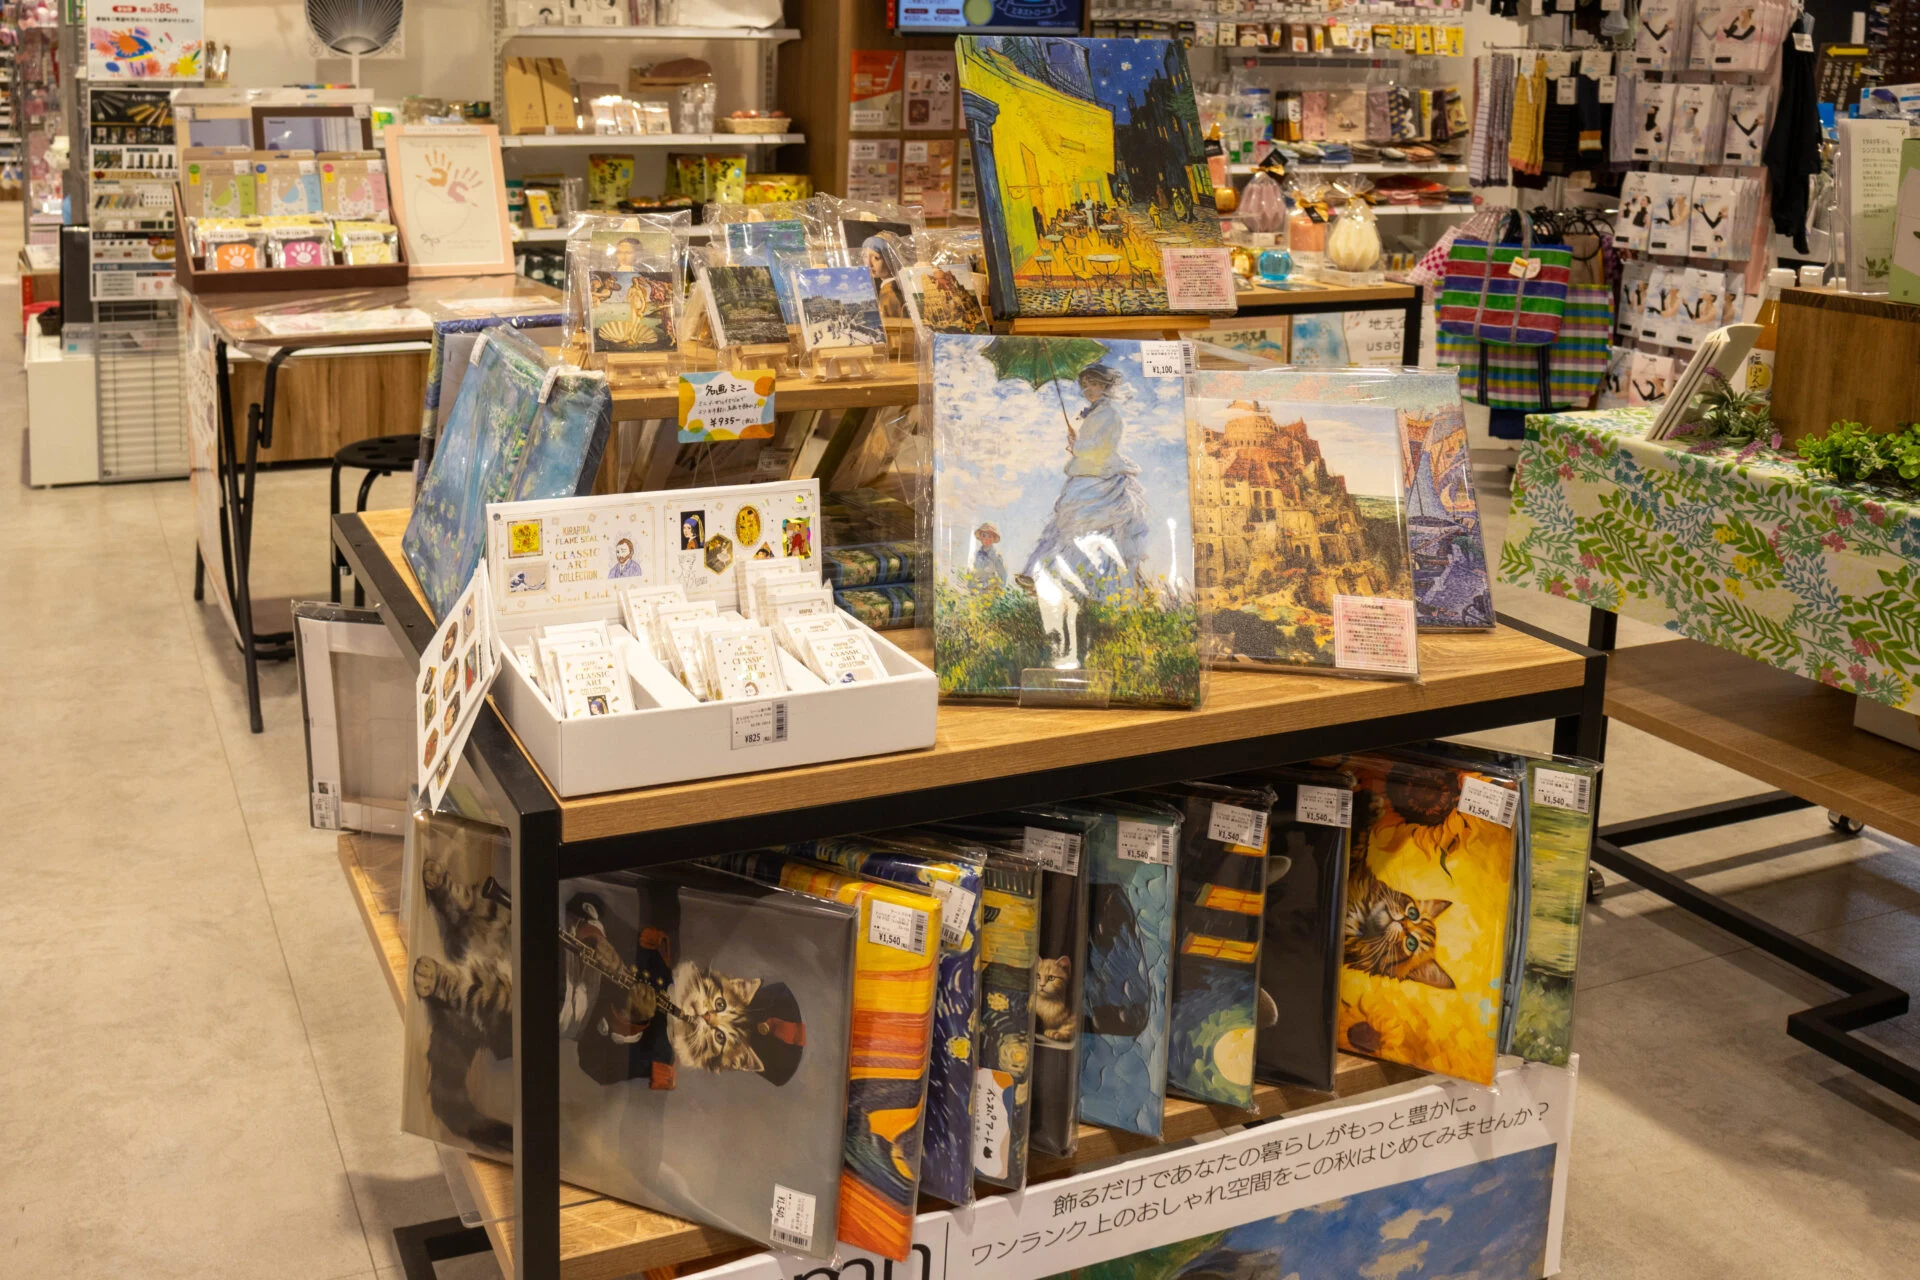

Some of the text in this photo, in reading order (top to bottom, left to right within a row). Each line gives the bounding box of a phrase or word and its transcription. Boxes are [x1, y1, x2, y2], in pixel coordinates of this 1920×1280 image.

[1224, 329, 1267, 343] コラボ文具
[1152, 365, 1173, 375] ¥1,100
[554, 548, 601, 561] CLASSIC
[568, 560, 589, 569] ART
[558, 570, 598, 583] COLLECTION
[575, 671, 611, 681] CLASSIC
[585, 679, 603, 687] ART
[745, 733, 761, 743] ¥825
[1543, 794, 1565, 806] ¥1,540
[1306, 811, 1328, 822] ¥1,540
[1468, 804, 1490, 817] ¥1,540
[1218, 829, 1240, 841] ¥1,540
[1127, 849, 1149, 859] ¥1,540
[879, 933, 901, 945] ¥1,540
[1052, 1096, 1477, 1217] 飾るだけであなたの暮らしがもっと豊かに。
[777, 1195, 786, 1219] ¥1,540
